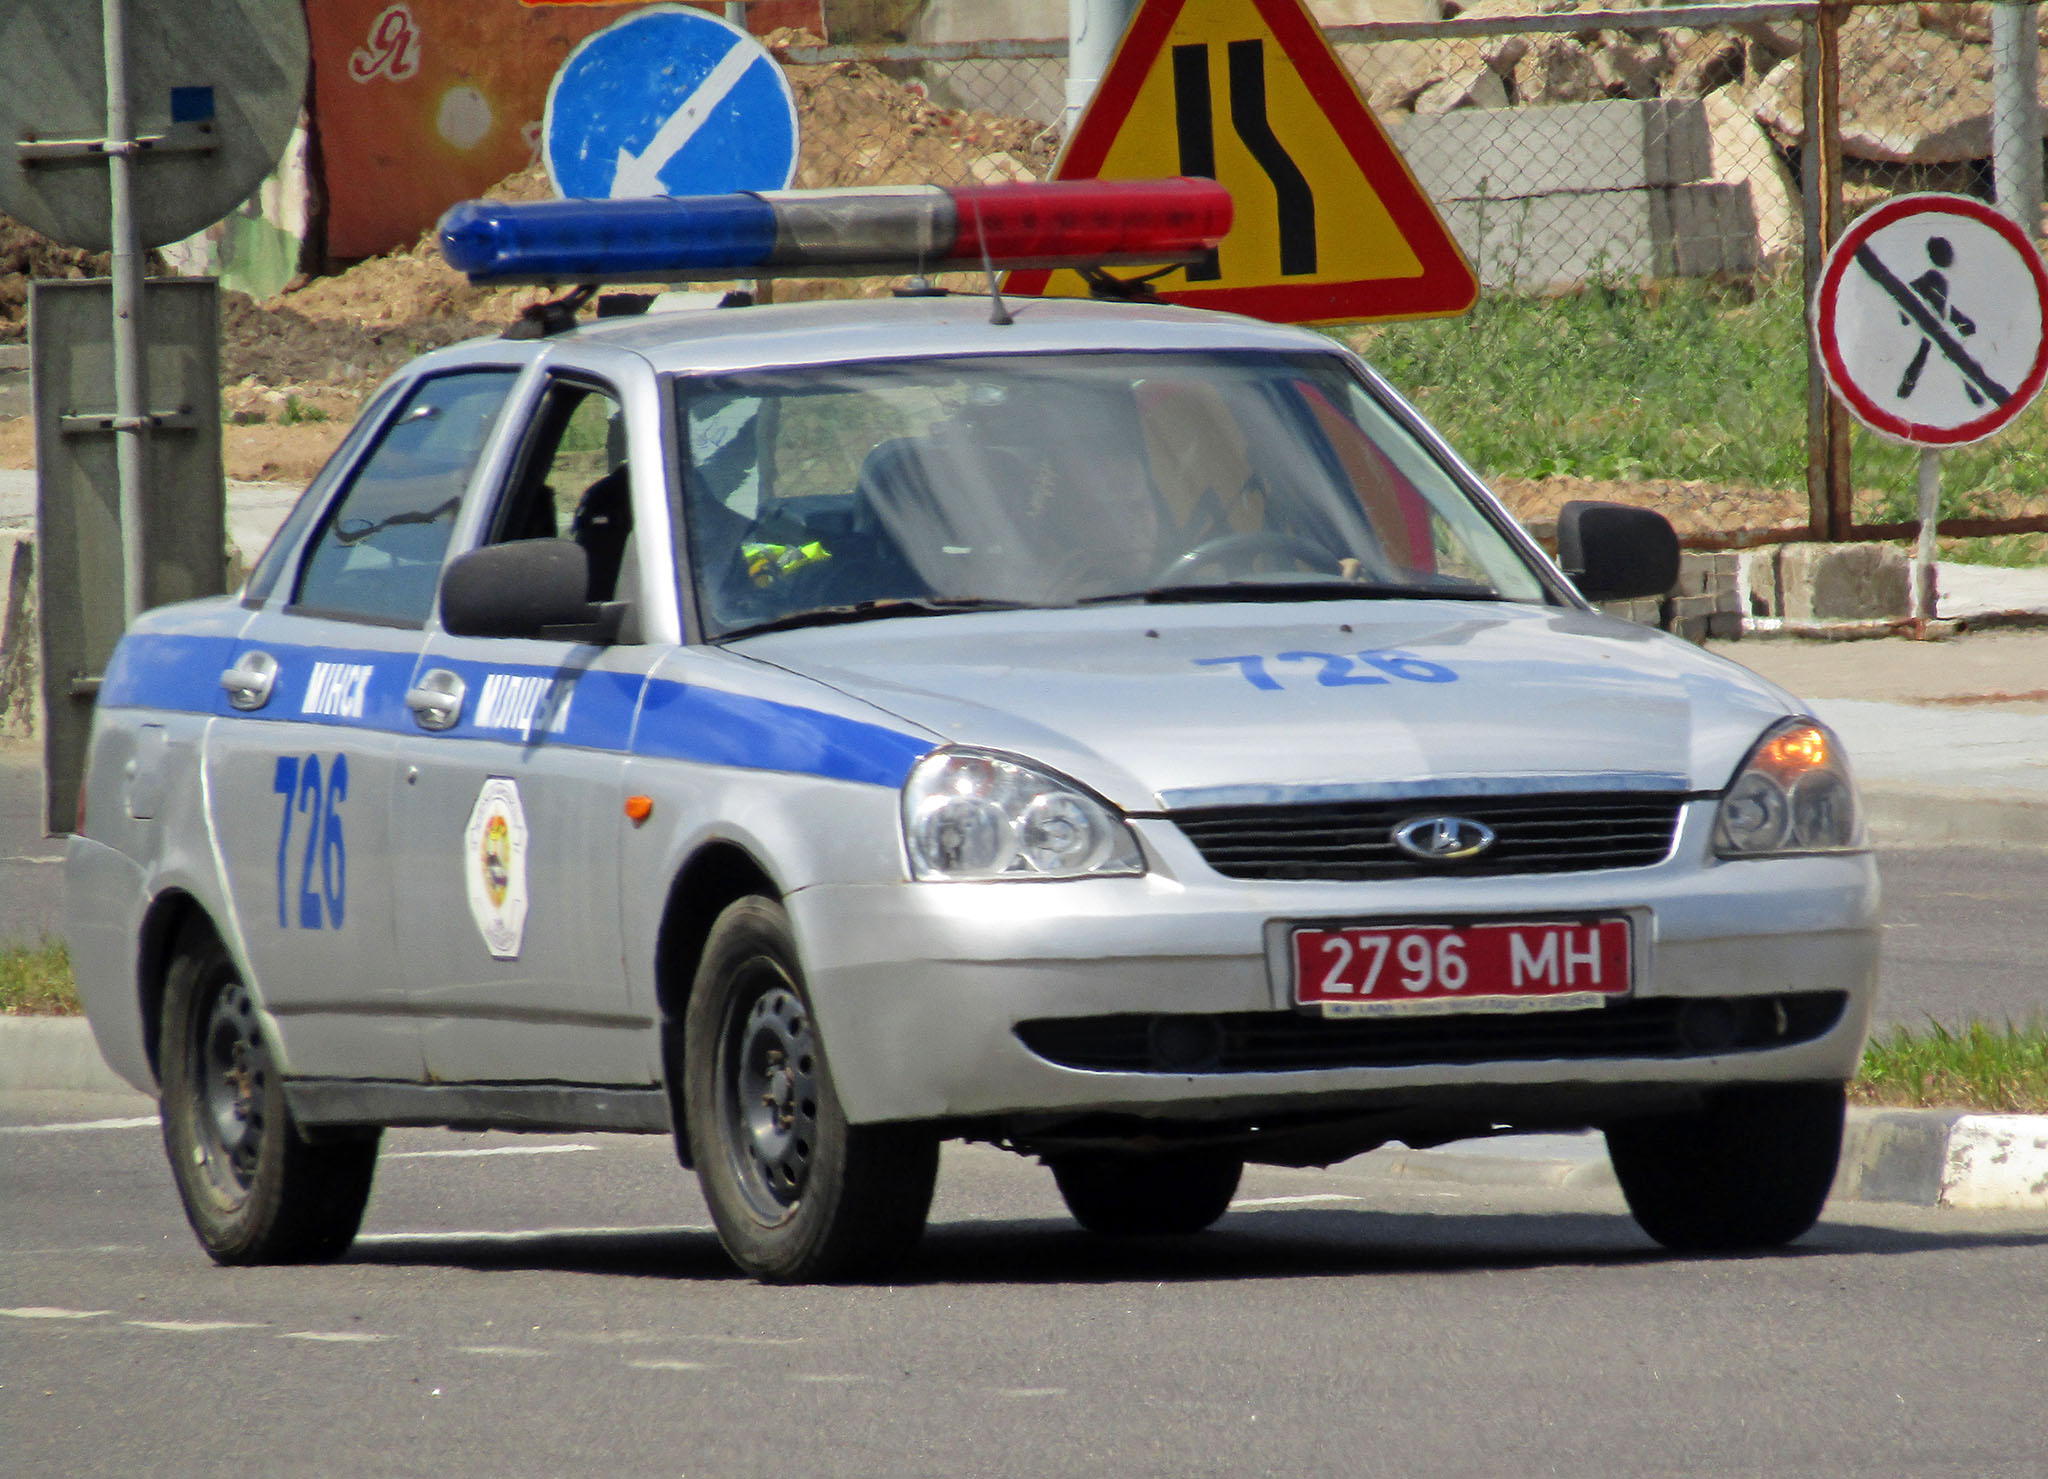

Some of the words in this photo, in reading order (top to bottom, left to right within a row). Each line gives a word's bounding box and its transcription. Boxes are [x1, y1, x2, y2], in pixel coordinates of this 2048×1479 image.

[1194, 650, 1459, 690] 726
[273, 753, 348, 930] 726
[1321, 934, 1469, 995] 2796
